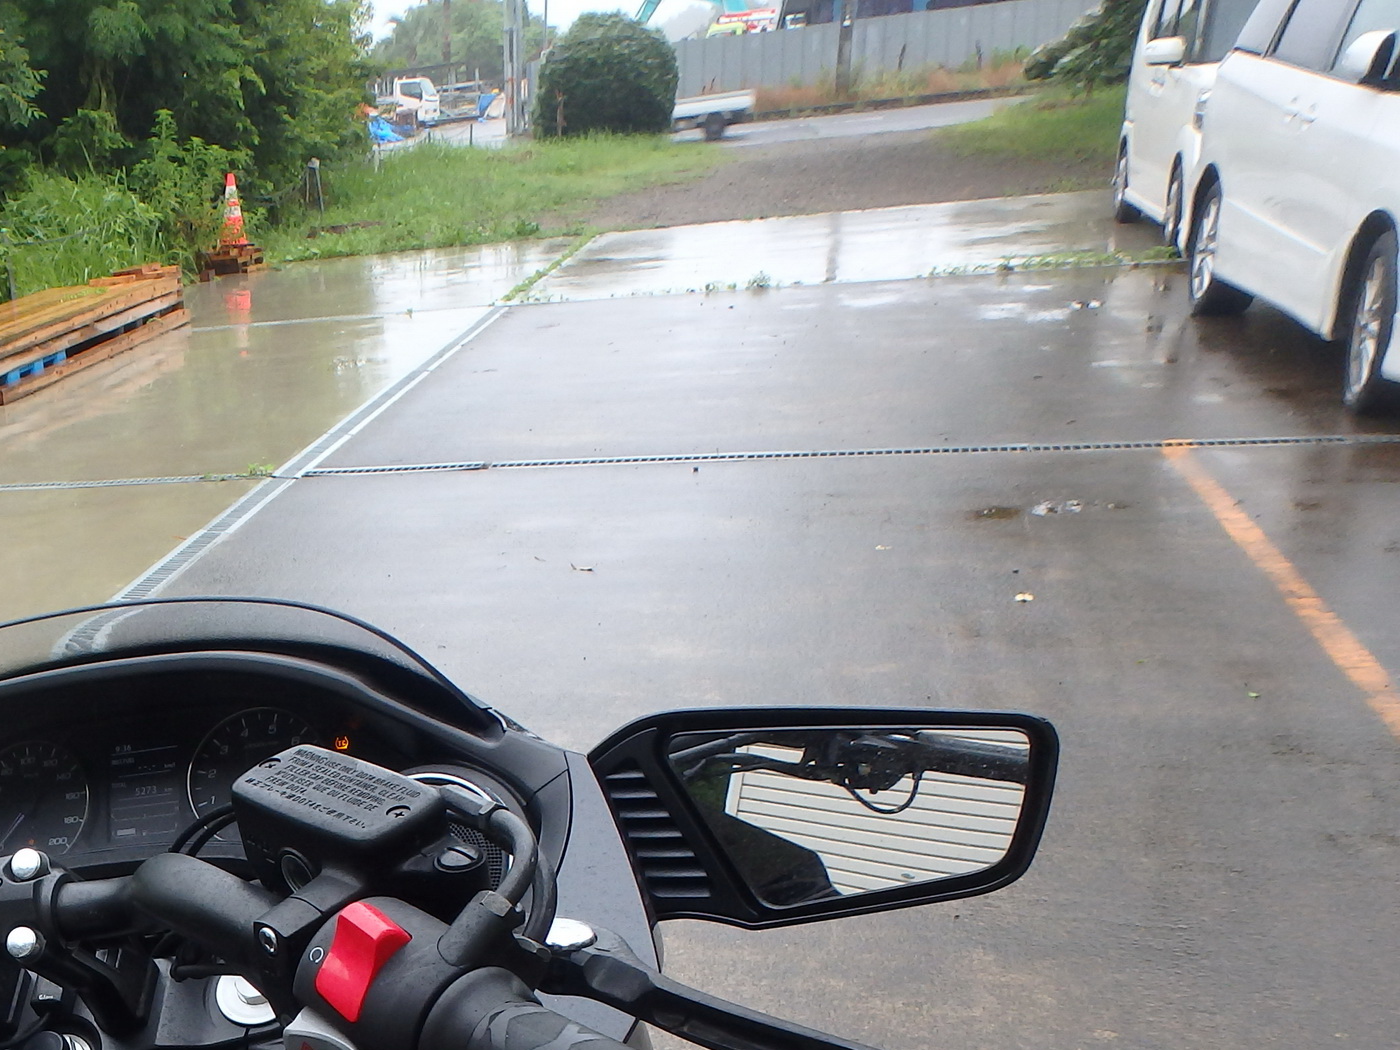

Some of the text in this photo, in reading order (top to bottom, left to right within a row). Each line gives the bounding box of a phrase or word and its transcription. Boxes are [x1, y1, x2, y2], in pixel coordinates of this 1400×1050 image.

[284, 764, 312, 777] FILLER
[307, 773, 325, 782] CAP
[320, 778, 352, 791] BEFORE
[311, 765, 342, 778] SEALED
[325, 760, 342, 769] USE
[373, 778, 400, 790] BRAKE
[135, 786, 157, 796] 5273
[48, 837, 68, 846] 200
